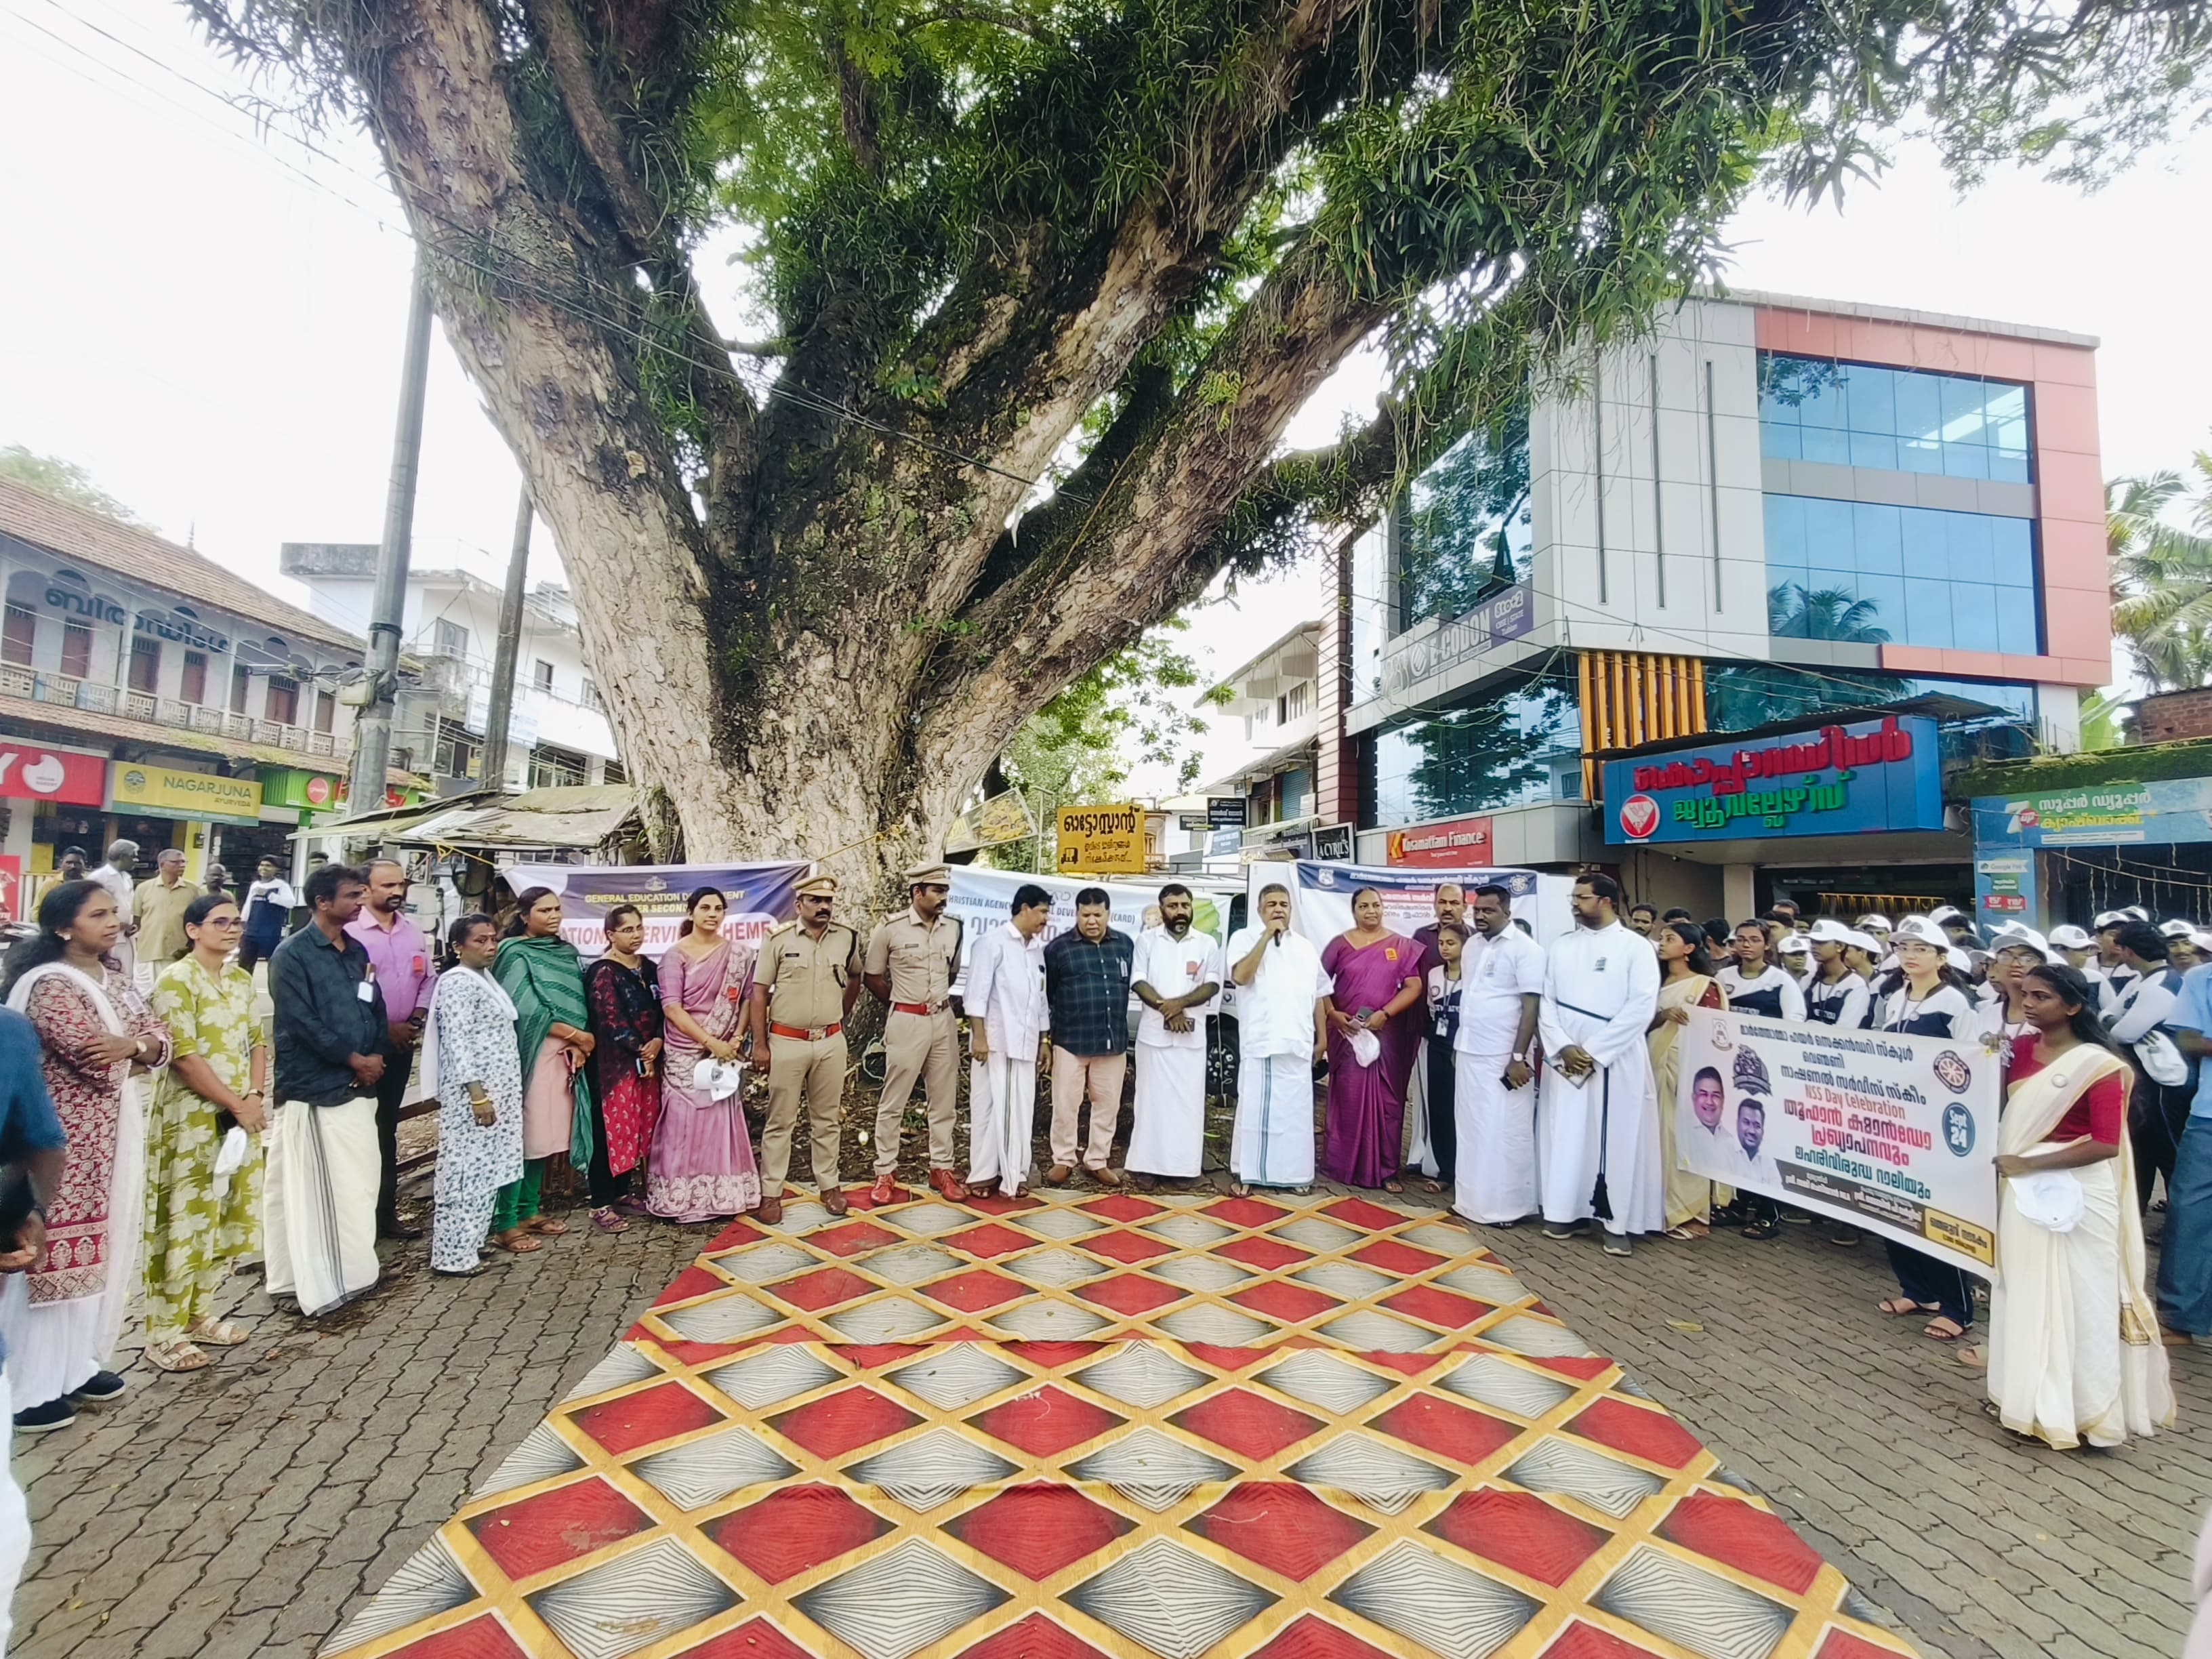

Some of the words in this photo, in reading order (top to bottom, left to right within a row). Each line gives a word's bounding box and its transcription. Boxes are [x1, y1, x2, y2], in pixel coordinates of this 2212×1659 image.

[1430, 608, 1491, 667] E-CODON
[163, 775, 252, 798] NAGARJUNA
[214, 798, 251, 807] AYURVEDA
[1448, 831, 1485, 847] Finance
[585, 894, 626, 903] GENERAL
[628, 892, 680, 903] EDUCATION
[949, 895, 983, 907] HRISTIAN
[1111, 912, 1135, 924] (CARD)
[1780, 1065, 1835, 1086] നാഷണൽ
[1805, 1084, 1823, 1102] NSS
[1824, 1087, 1844, 1109] Day
[1845, 1092, 1906, 1120] Celebration
[1949, 1109, 1967, 1128] Sept
[1950, 1125, 1967, 1149] 24
